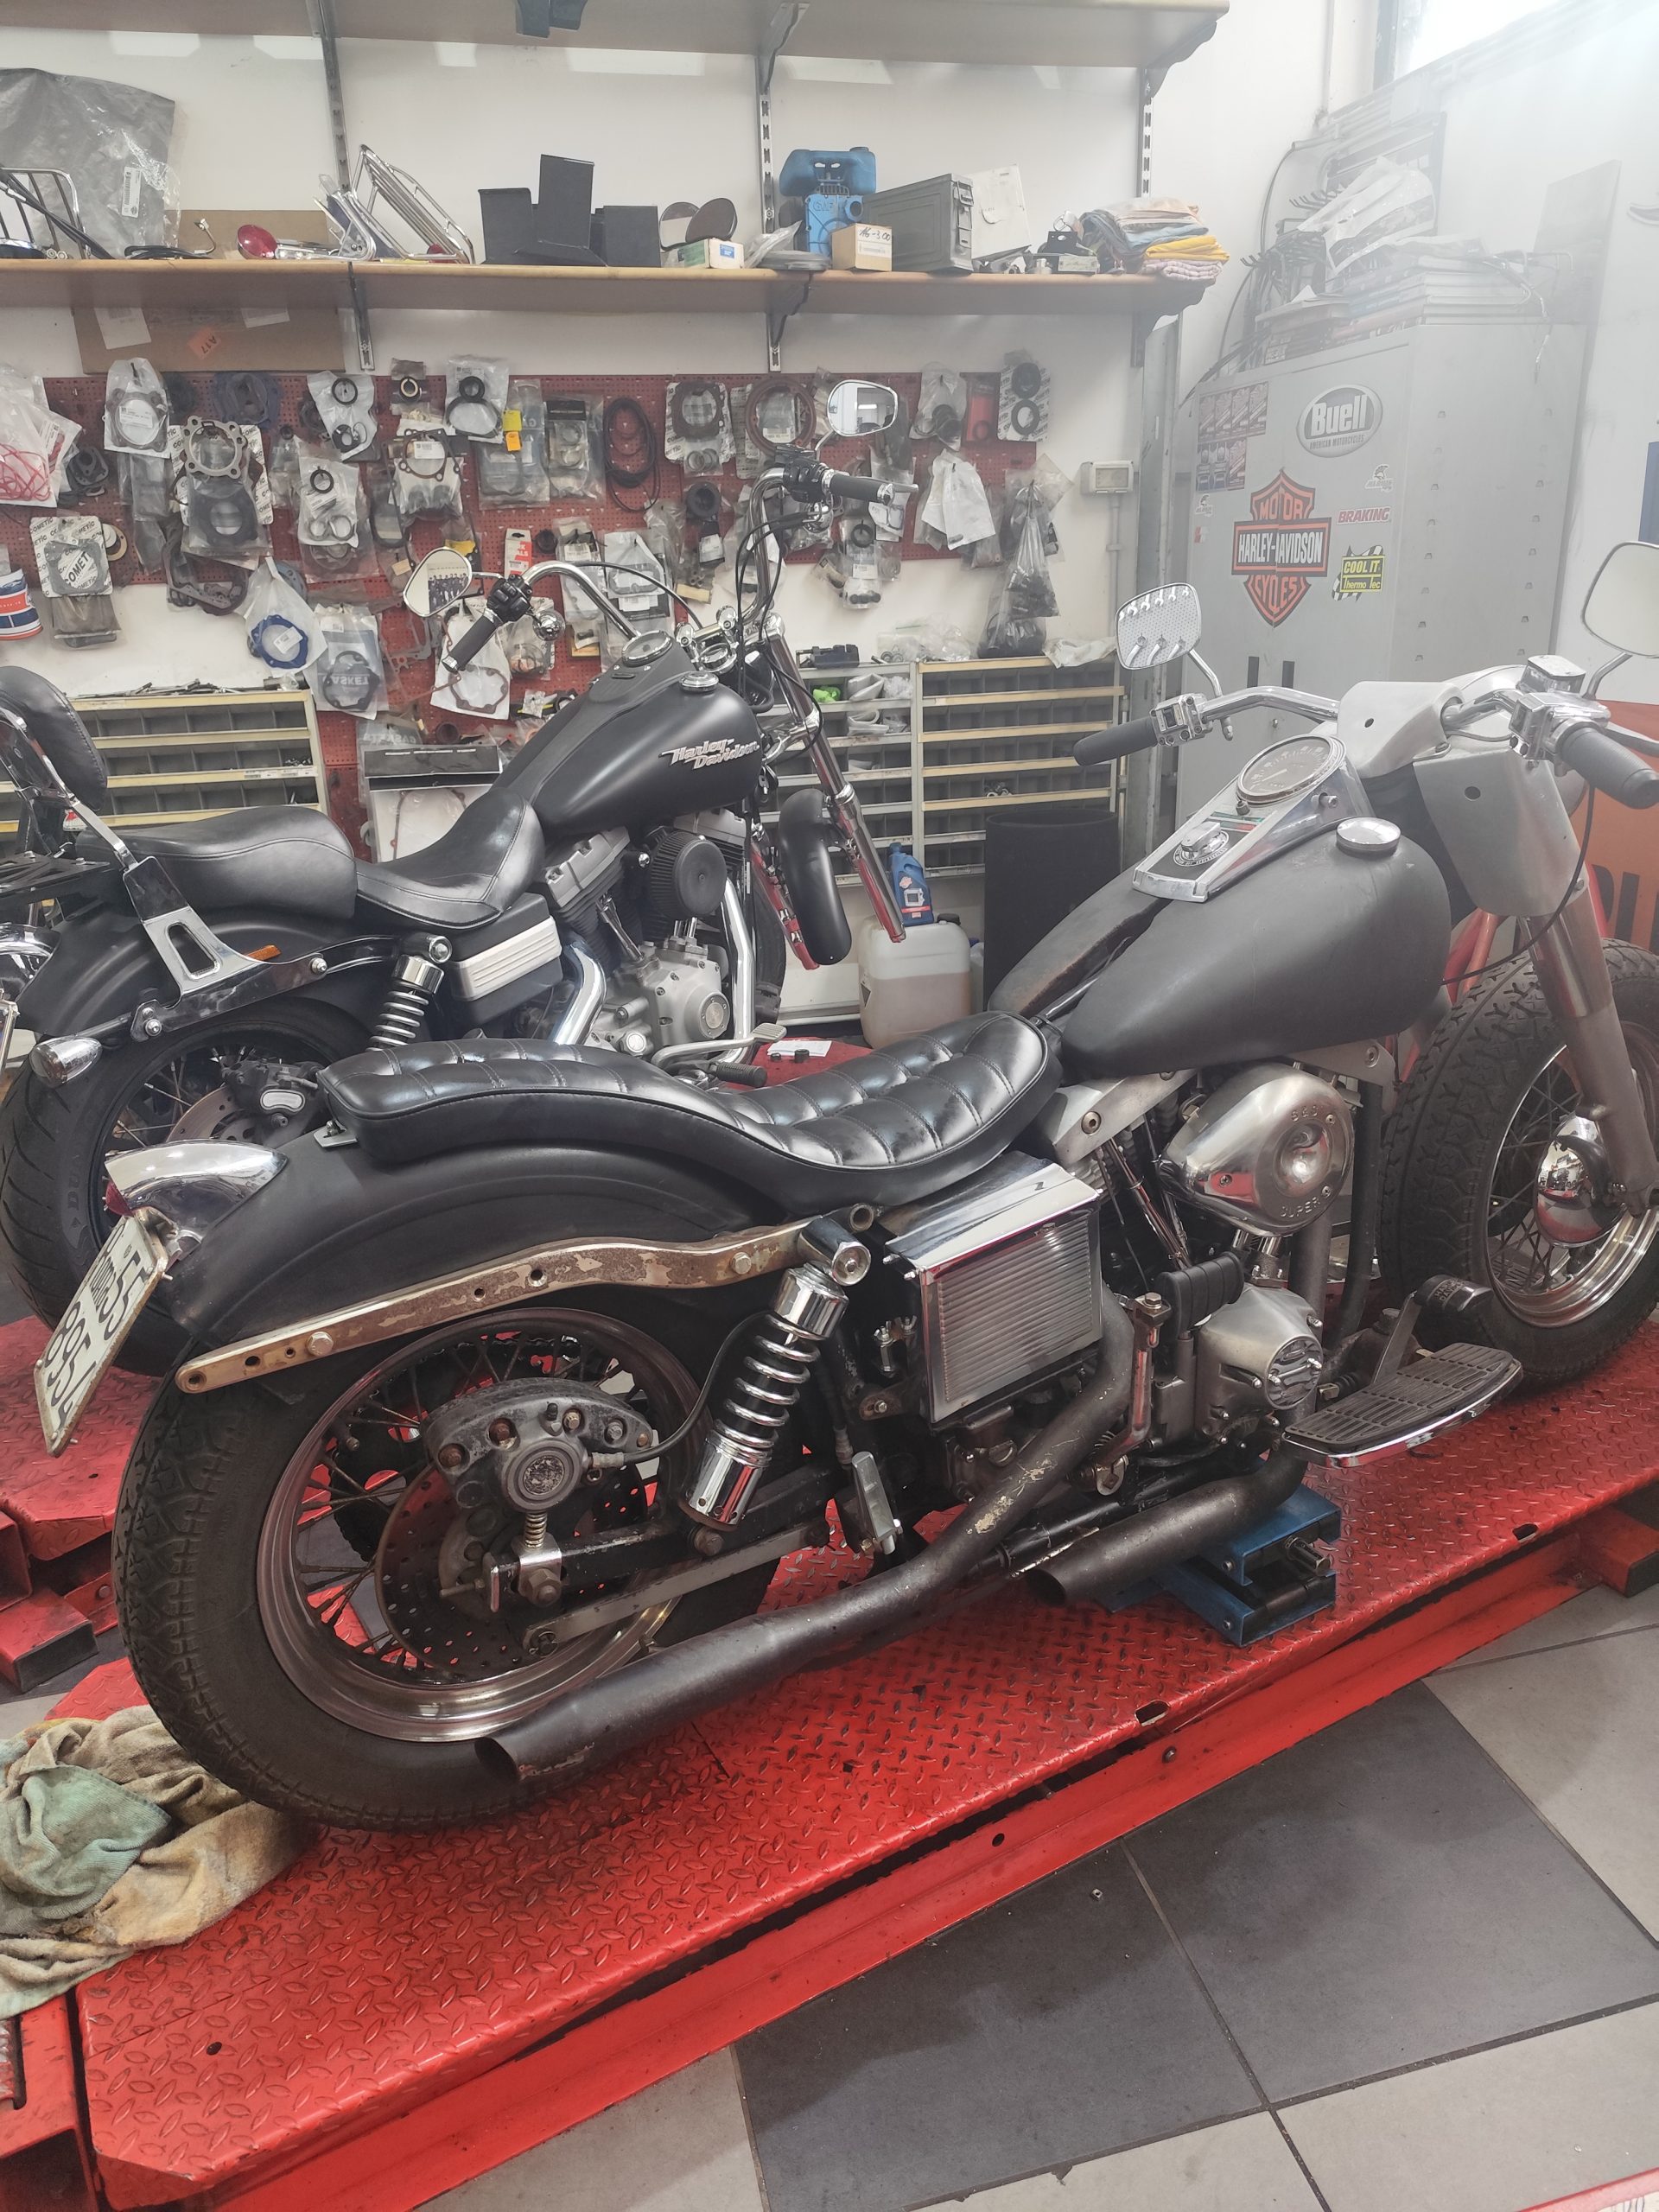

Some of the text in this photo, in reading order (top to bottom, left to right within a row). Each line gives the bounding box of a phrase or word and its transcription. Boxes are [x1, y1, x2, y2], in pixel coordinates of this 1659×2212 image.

[1310, 394, 1368, 436] Buell
[1338, 507, 1390, 524] BRAKING
[1343, 560, 1381, 574] COOL IT
[1343, 576, 1381, 589] Thermo Tec
